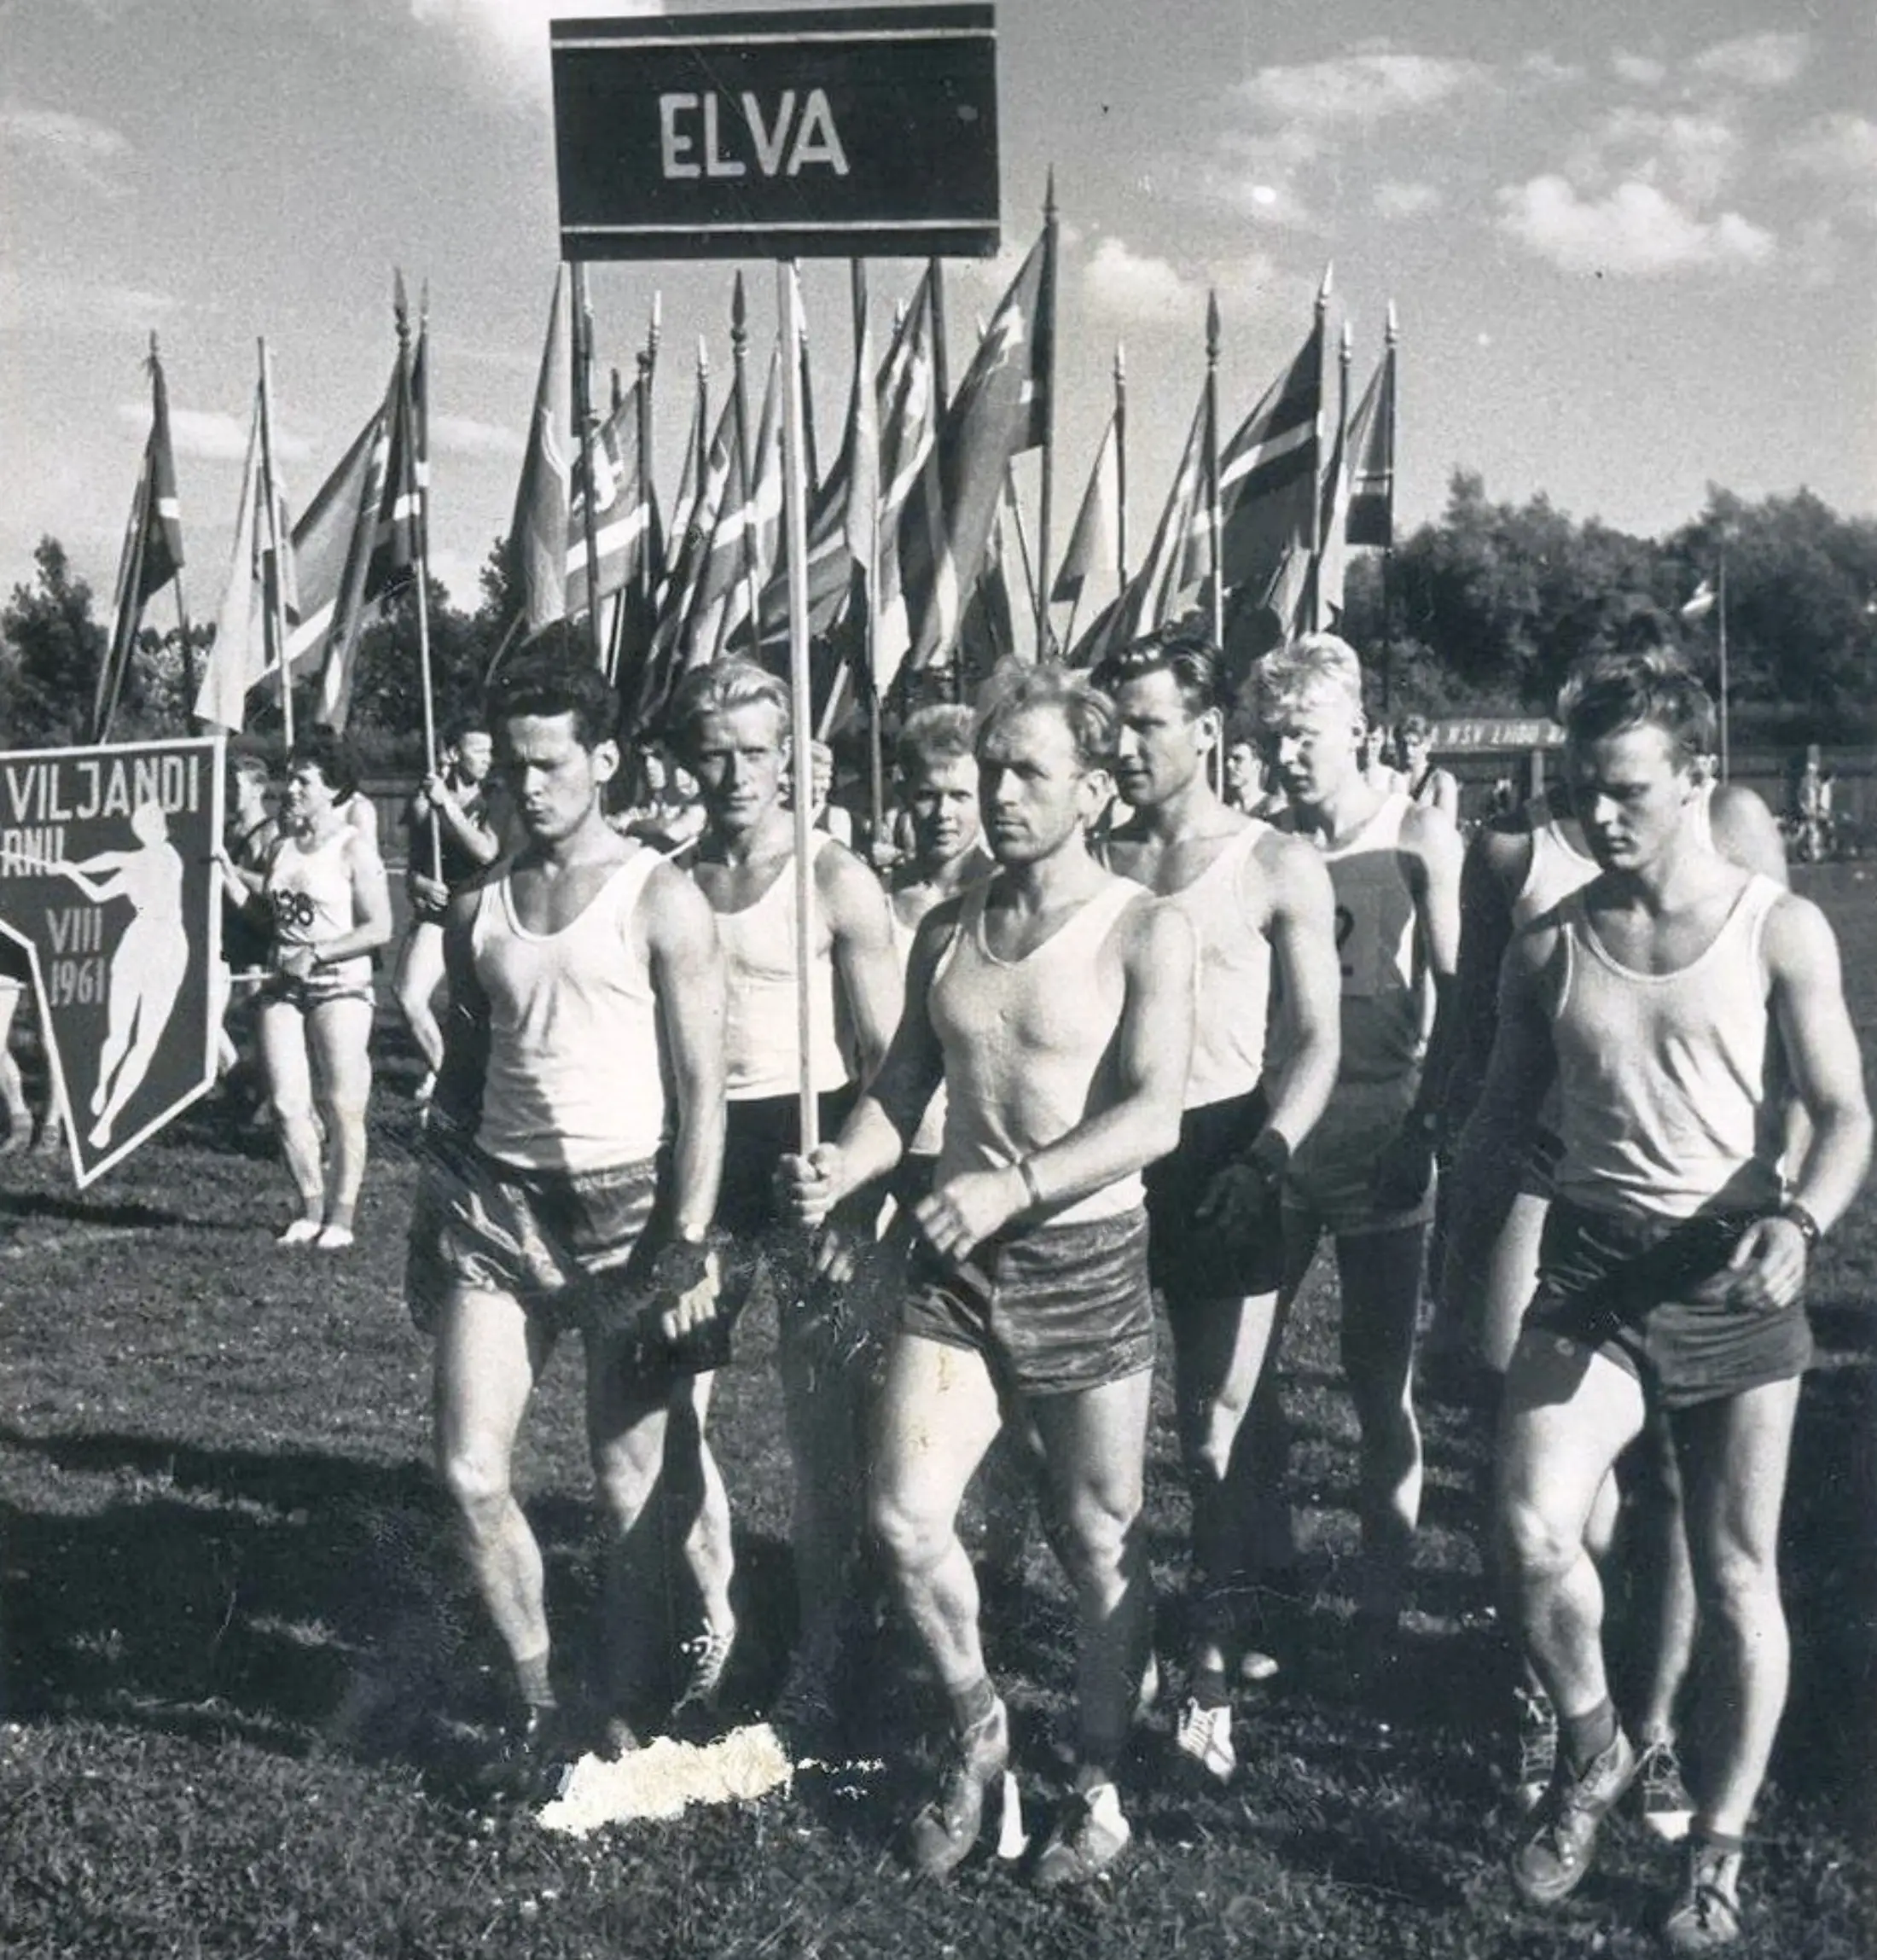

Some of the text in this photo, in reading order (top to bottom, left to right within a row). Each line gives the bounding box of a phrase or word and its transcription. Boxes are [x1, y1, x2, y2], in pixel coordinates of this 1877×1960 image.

[660, 88, 849, 178] ELVA
[5, 755, 199, 822] VILJANDI
[45, 907, 102, 953] VIII
[51, 957, 104, 1007] 1961
